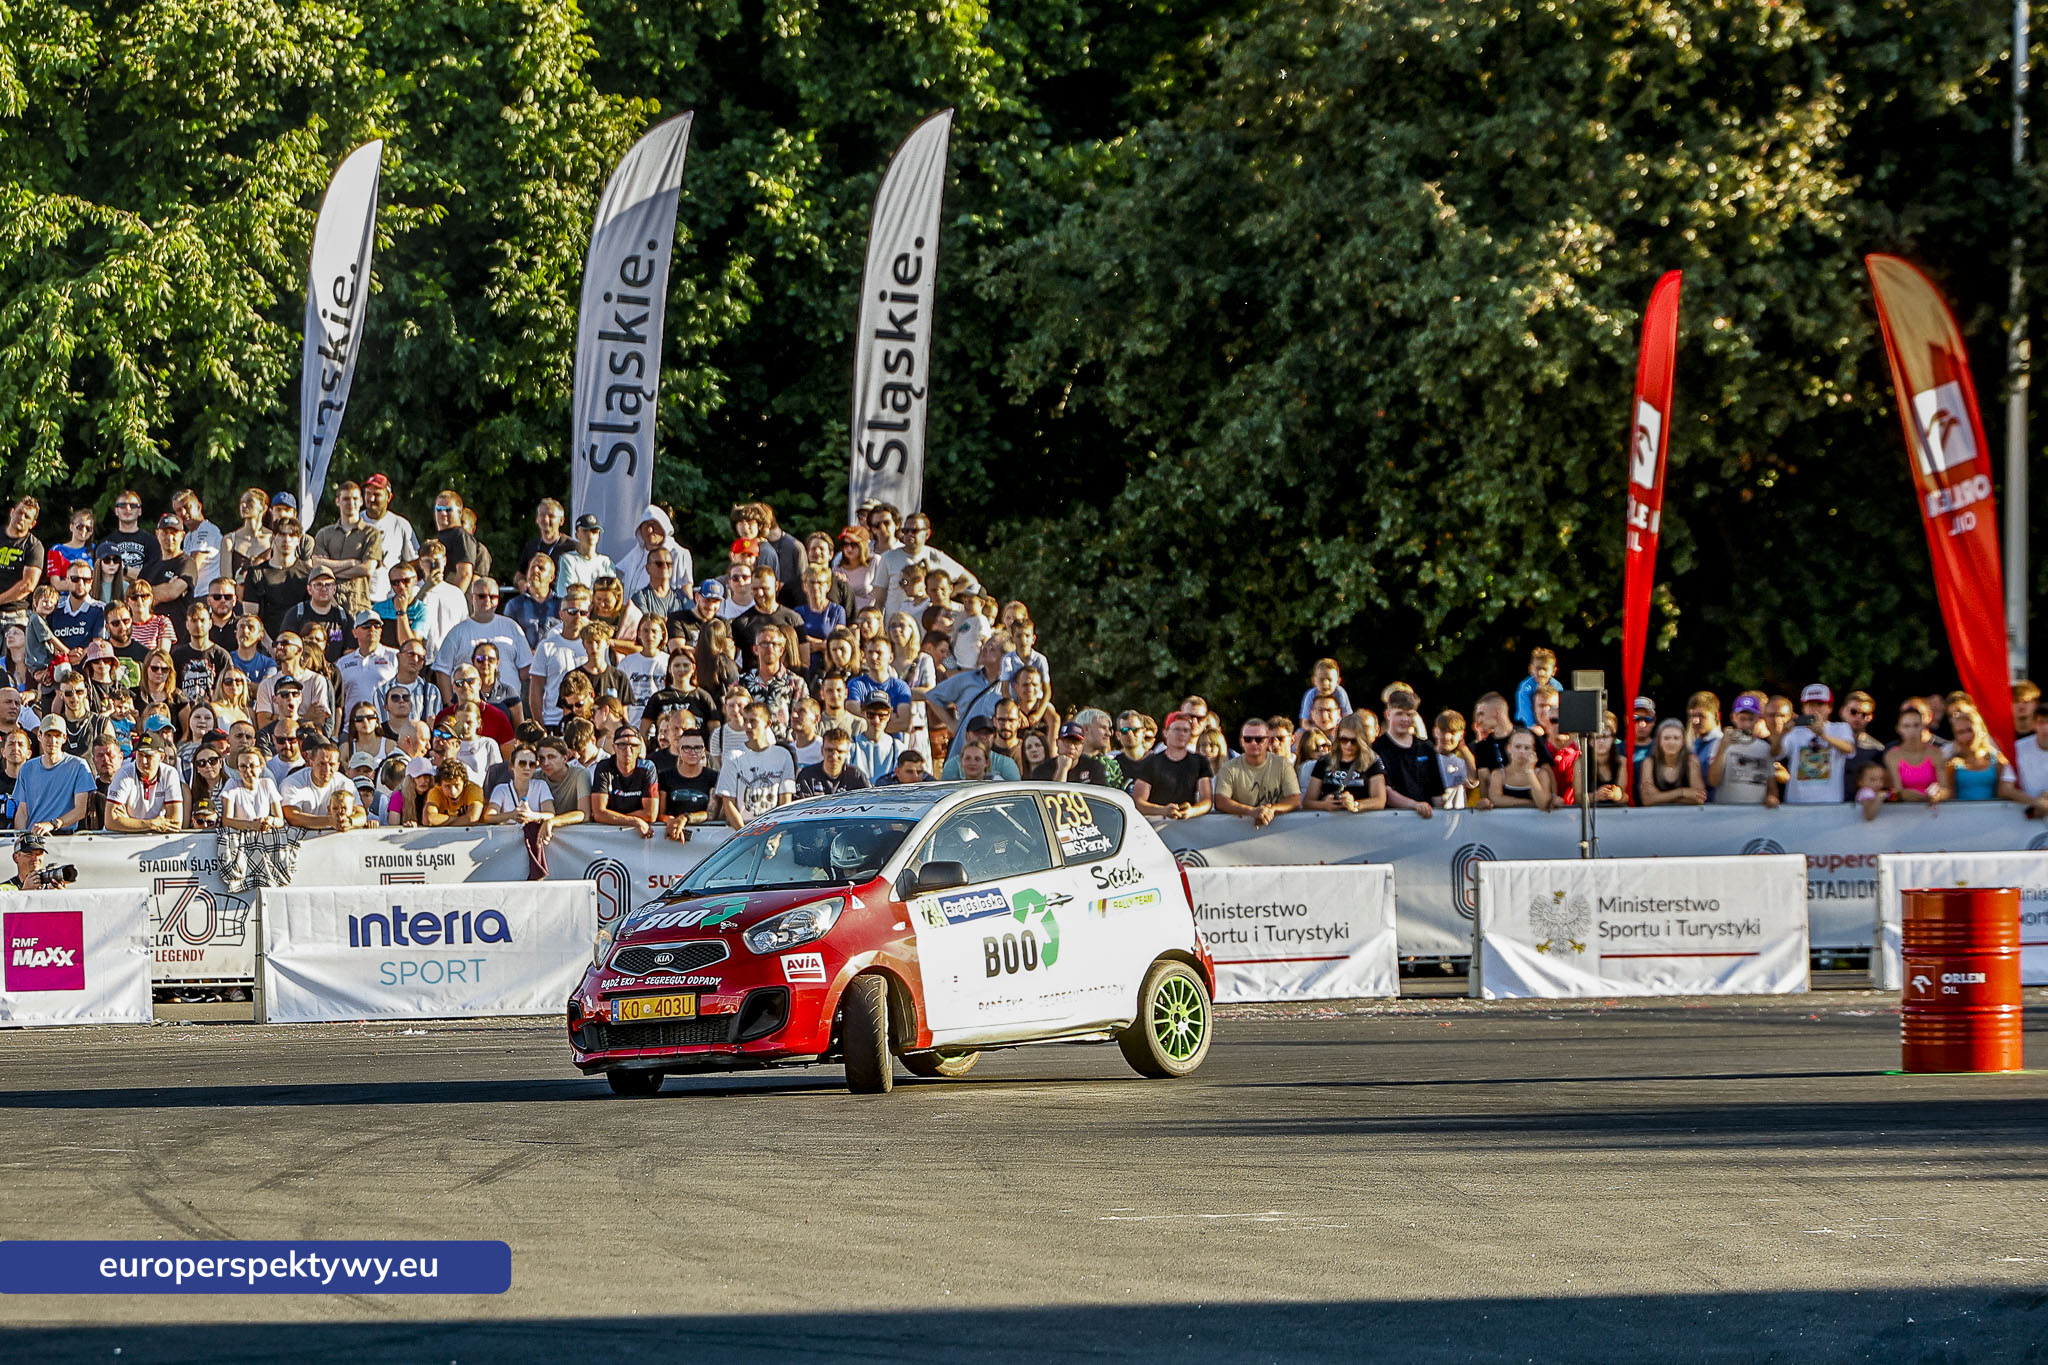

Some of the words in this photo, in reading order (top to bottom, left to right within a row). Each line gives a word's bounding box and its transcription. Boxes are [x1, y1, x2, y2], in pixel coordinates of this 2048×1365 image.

[54, 626, 85, 637] adidas
[1045, 792, 1093, 831] 239
[139, 860, 187, 873] STADION
[190, 857, 218, 875] ŚLĄS
[365, 855, 413, 868] STADION
[416, 852, 456, 870] ŚLĄSKI
[1598, 896, 1720, 914] Ministerstwo
[348, 905, 513, 948] interia
[1254, 925, 1259, 943] i
[1264, 921, 1350, 944] Turystyki
[1598, 920, 1660, 941] Sportu
[1666, 920, 1671, 936] i
[1676, 918, 1761, 940] Turystyki
[11, 937, 39, 948] RMF
[155, 934, 175, 947] LAT
[155, 949, 205, 962] LEGENDY
[655, 953, 672, 964] KIA
[380, 959, 487, 986] SPORT
[1941, 972, 1986, 984] ORLEN
[600, 976, 621, 990] BĄDŹ
[621, 977, 636, 987] EKO
[645, 975, 687, 985] SEGREGUJ
[687, 976, 723, 986] ODPADY
[1942, 986, 1959, 994] OIL
[654, 997, 691, 1017] 403U
